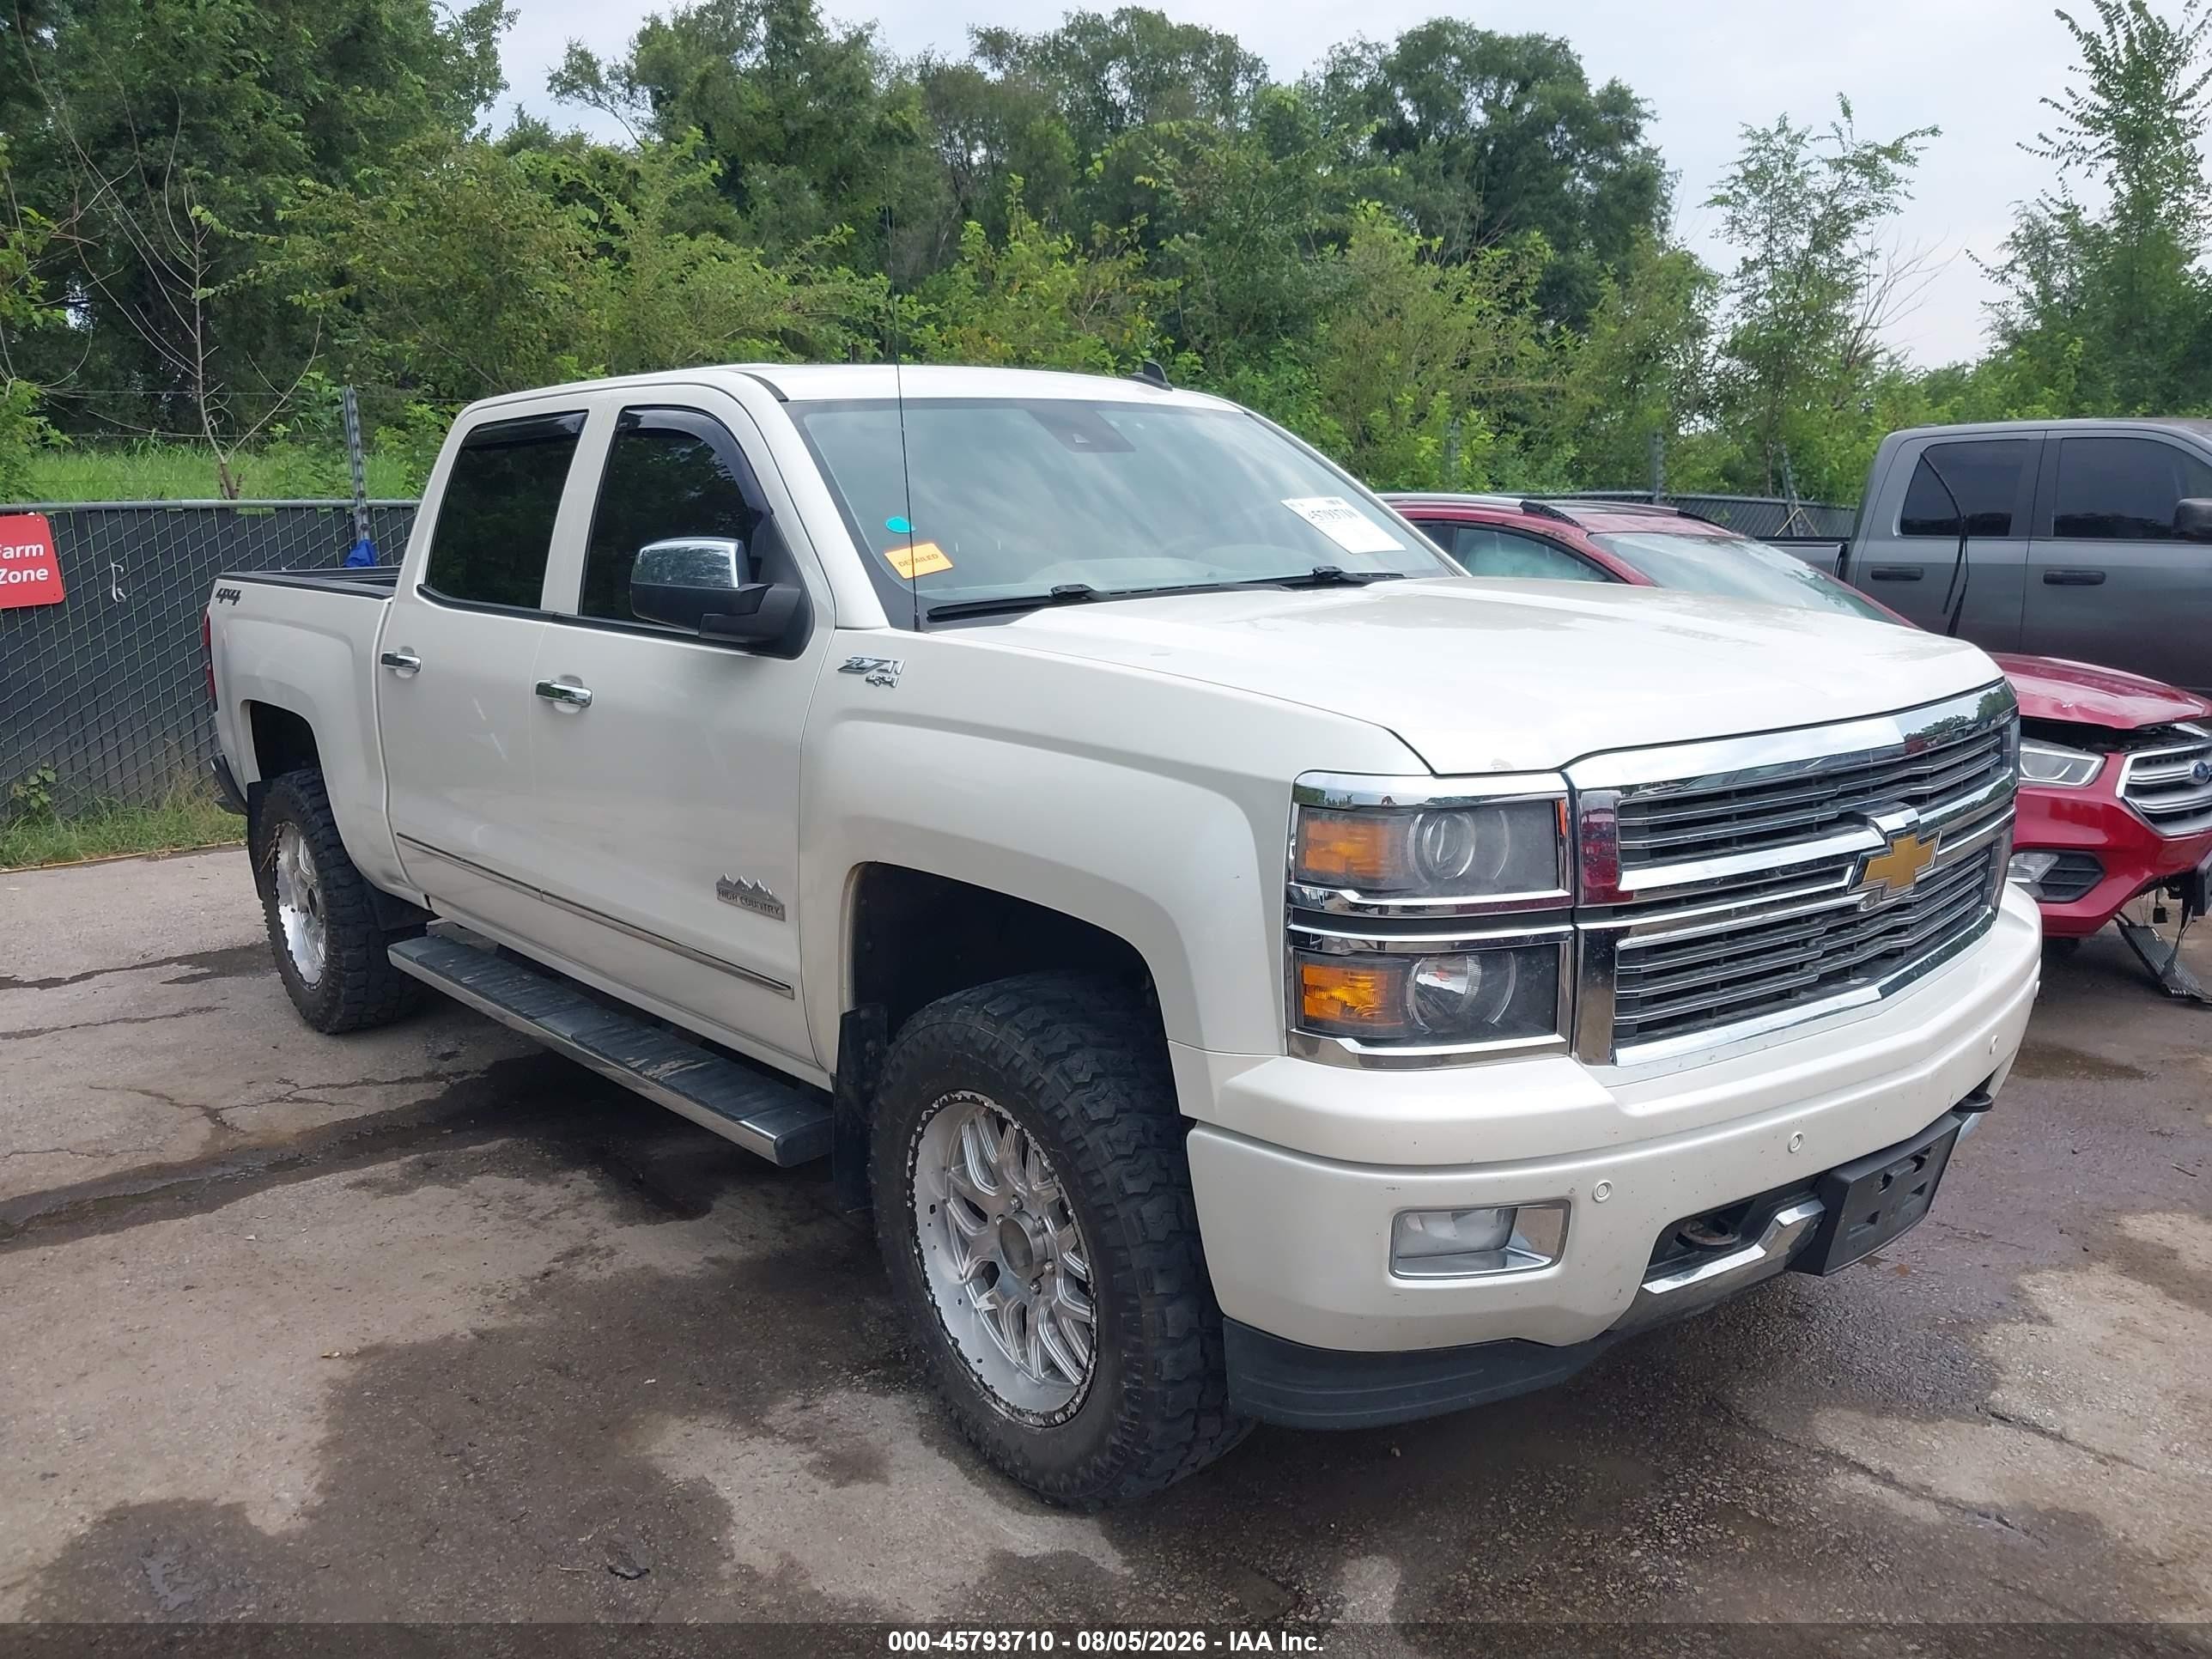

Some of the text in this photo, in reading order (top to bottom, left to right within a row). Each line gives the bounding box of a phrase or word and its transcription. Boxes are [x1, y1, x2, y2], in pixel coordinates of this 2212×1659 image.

[0, 544, 45, 559] arm
[898, 553, 939, 568] DETAILED
[0, 568, 49, 585] Zone
[837, 655, 906, 675] Z71
[718, 889, 780, 915] HIGH COUNTRY
